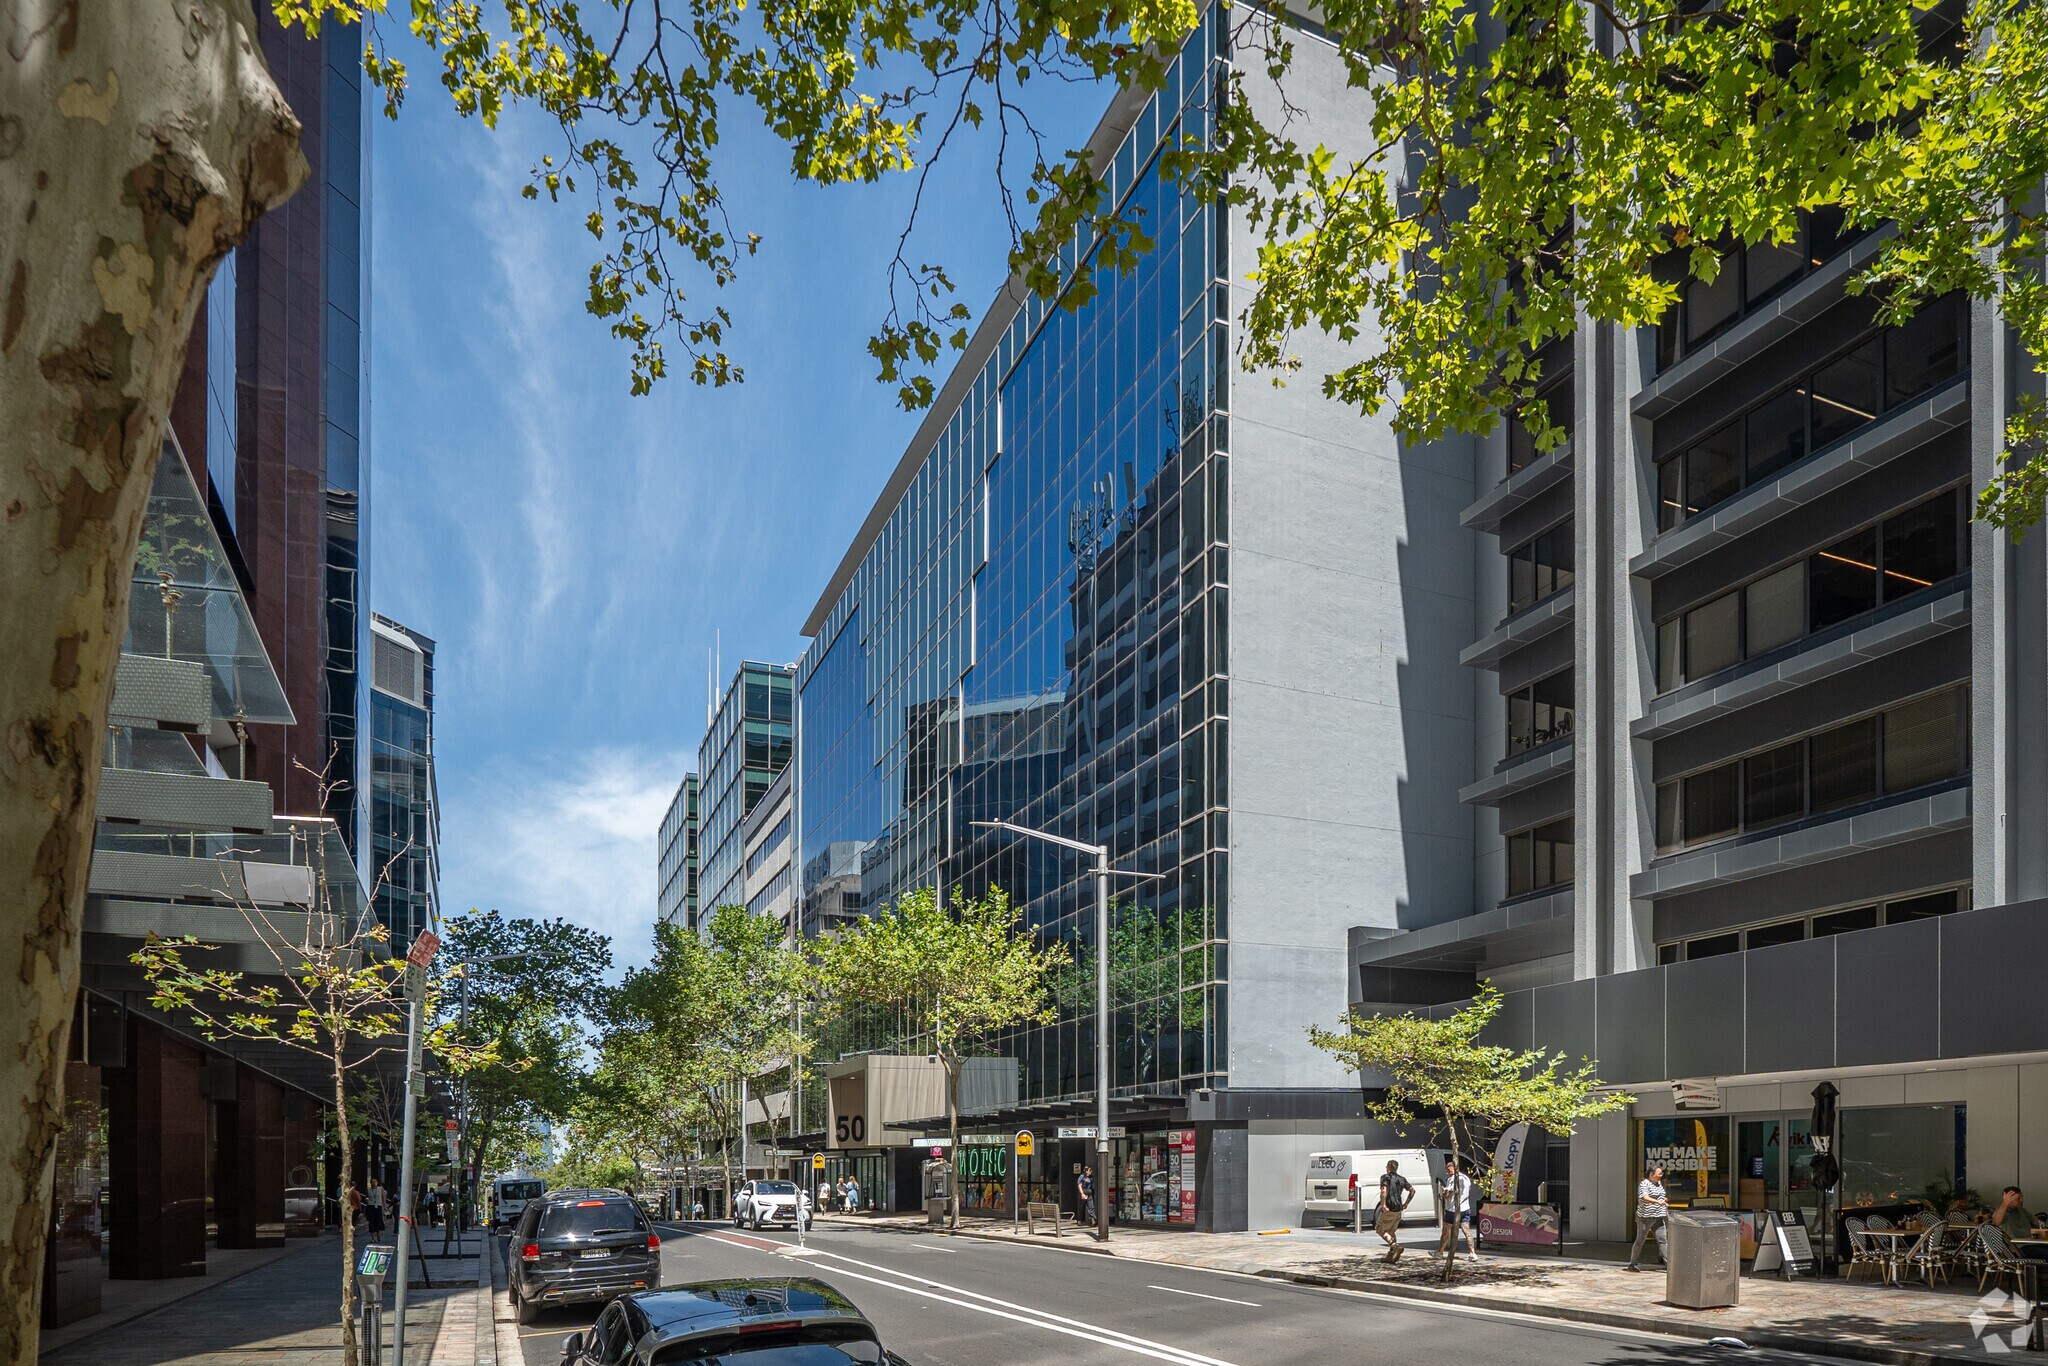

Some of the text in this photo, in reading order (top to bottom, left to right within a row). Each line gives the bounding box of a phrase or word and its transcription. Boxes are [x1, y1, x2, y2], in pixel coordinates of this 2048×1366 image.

[836, 1115, 865, 1142] 50
[1504, 1138, 1520, 1169] Kopy
[1646, 1146, 1717, 1159] WE MAKE
[1646, 1159, 1717, 1171] POSSIBLE
[1492, 1228, 1513, 1236] DESIGN
